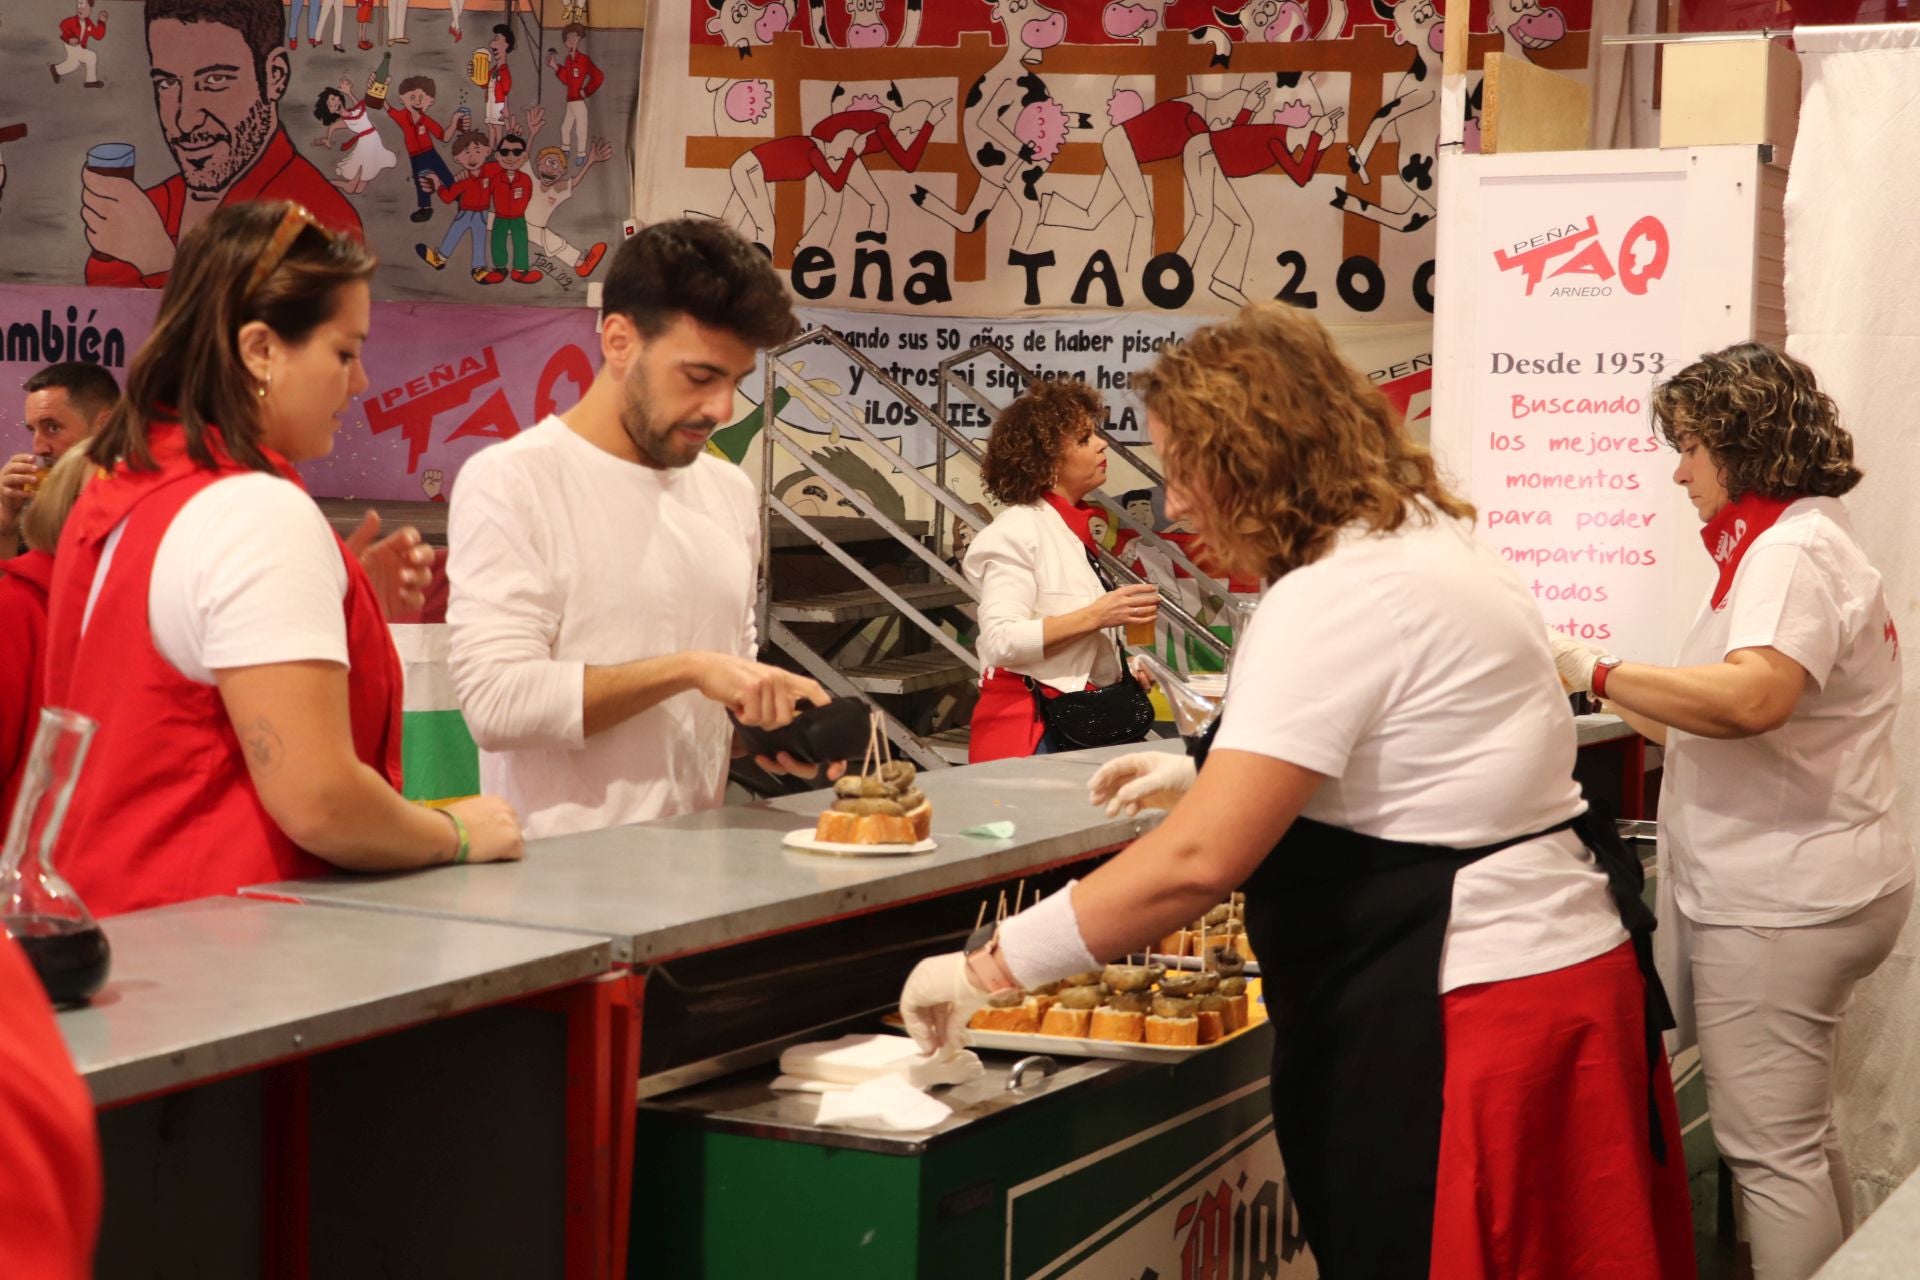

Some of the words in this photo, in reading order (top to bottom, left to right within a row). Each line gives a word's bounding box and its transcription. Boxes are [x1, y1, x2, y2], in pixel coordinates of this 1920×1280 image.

[1513, 223, 1580, 254] PEÑA
[752, 230, 953, 306] eña
[1008, 248, 1195, 310] TAO
[1550, 286, 1613, 297] ARNEDO
[0, 305, 125, 368] mbién
[898, 332, 928, 350] sus
[936, 328, 960, 350] 50
[969, 327, 1014, 351] años
[1023, 330, 1046, 352] de
[1055, 329, 1114, 353] haber
[1490, 352, 1581, 375] Desde
[1594, 352, 1665, 375] 1953
[383, 355, 485, 408] PEÑA
[849, 365, 865, 396] y
[1511, 394, 1641, 420] Buscando
[1490, 431, 1526, 451] los
[1549, 432, 1659, 456] mejores
[1506, 469, 1640, 490] momentos
[1488, 510, 1552, 529] para
[1576, 509, 1656, 531] poder
[1494, 543, 1656, 568] ompartirlos
[1531, 579, 1608, 602] todos
[1546, 617, 1612, 640] tos
